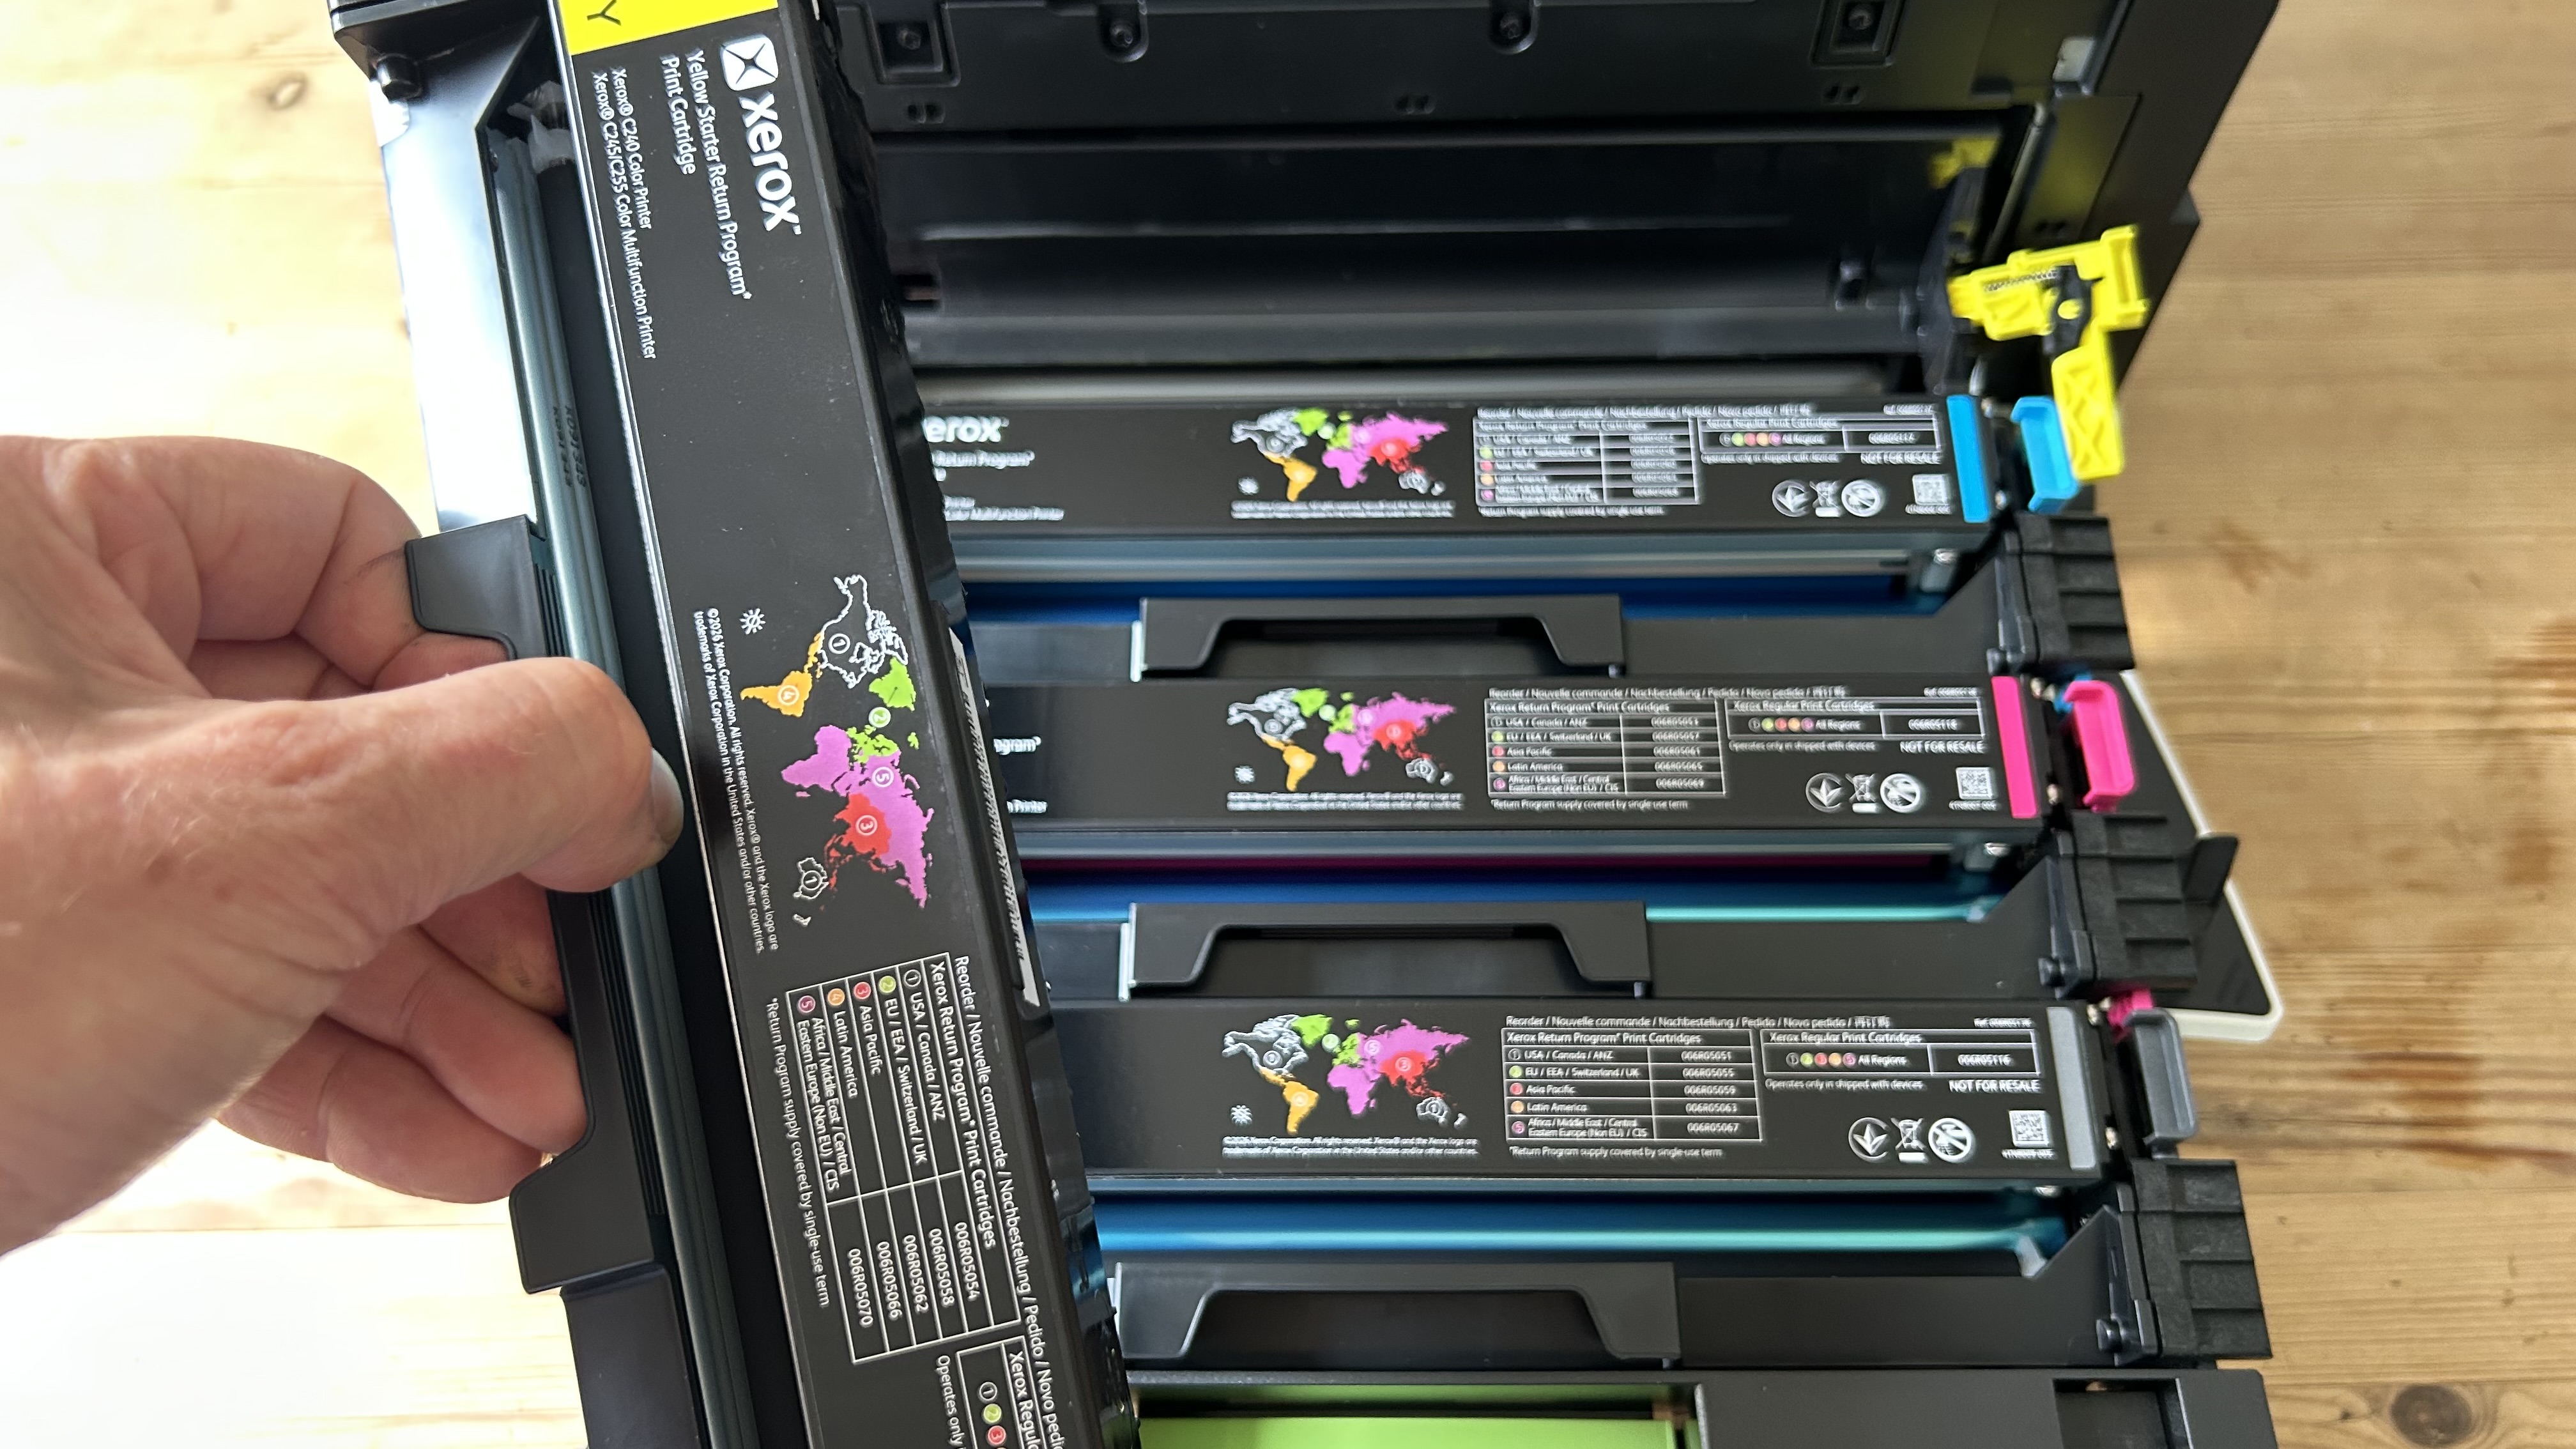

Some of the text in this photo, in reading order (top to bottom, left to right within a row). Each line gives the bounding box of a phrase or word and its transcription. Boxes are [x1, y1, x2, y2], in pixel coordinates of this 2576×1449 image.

[586, 0, 622, 26] Y
[686, 49, 709, 103] Yellow
[661, 55, 697, 175] Print Cartridge
[695, 103, 721, 162] Starter
[620, 116, 641, 152] C240
[602, 121, 629, 194] C245/C255
[626, 152, 645, 187] Color
[633, 186, 652, 229] Printer
[707, 162, 732, 221] Return
[614, 193, 633, 228] Color
[620, 229, 648, 316] Multifunction
[636, 314, 656, 359] Printer
[923, 415, 1002, 443] erox
[693, 610, 713, 663] trademarks
[703, 663, 716, 673] of
[712, 641, 726, 669] Xerox
[705, 673, 719, 702] Xerox
[710, 701, 729, 756] Corporation
[728, 726, 742, 739] All
[721, 756, 731, 767] in
[730, 739, 745, 766] rights
[1899, 740, 1985, 753] NOT FOR RESALE
[723, 767, 735, 783] the
[726, 783, 742, 817] United
[733, 816, 746, 847] States
[739, 848, 752, 879] and/or
[752, 845, 765, 865] and
[756, 864, 767, 882] the
[744, 880, 756, 905] other
[759, 882, 771, 910] Xerox
[763, 910, 776, 933] logo
[769, 933, 779, 950] are
[930, 960, 949, 1005] Xerox
[859, 1006, 874, 1032] Asia
[884, 997, 900, 1017] EU
[910, 992, 926, 1022] USA
[797, 1019, 813, 1062] Eastern
[811, 1017, 826, 1051] Africa
[833, 1010, 849, 1043] Latin
[890, 1028, 906, 1055] EEA
[939, 1006, 958, 1056] Return
[1506, 1031, 1537, 1043] Xerox
[1538, 1031, 1572, 1043] Return
[1622, 1032, 1648, 1044] Print
[1648, 1032, 1702, 1045] Cartridges
[1769, 1031, 1922, 1043] Xerox Regular Print Cartridges
[774, 1044, 792, 1097] Program
[839, 1045, 858, 1098] America
[864, 1033, 883, 1075] Pacific
[917, 1032, 937, 1082] Canada
[804, 1062, 821, 1103] Europe
[818, 1057, 836, 1097] Middle
[1948, 1079, 2041, 1092] NOT FOR RESALE
[826, 1097, 841, 1124] East
[897, 1064, 923, 1135] Switzerland
[928, 1092, 946, 1121] ANZ
[783, 1098, 802, 1138] supply
[811, 1104, 827, 1135] (Non
[817, 1134, 834, 1157] EU)
[832, 1131, 852, 1175] Central
[912, 1142, 928, 1164] UK
[962, 1129, 982, 1167] Print
[791, 1140, 812, 1191] covered
[824, 1169, 839, 1192] CIS
[954, 955, 976, 1010] Reorder
[967, 1021, 992, 1084] Nouvelle
[980, 1085, 1008, 1167] commande
[999, 1178, 1031, 1294] Nachbestellung
[1023, 1304, 1046, 1358] Pedido
[1036, 1368, 1054, 1411] Novo
[799, 1191, 813, 1208] by
[970, 1169, 996, 1248] Cartridges
[804, 1209, 824, 1273] single-use
[903, 1234, 929, 1312] 006R05062
[928, 1228, 955, 1306] 006R05058
[954, 1222, 980, 1301] 006R05054
[815, 1274, 829, 1306] term
[847, 1248, 873, 1326] 006R05070
[876, 1241, 903, 1320] 006R05066
[1009, 1351, 1027, 1399] Xerox
[935, 1354, 965, 1445] Operates only
